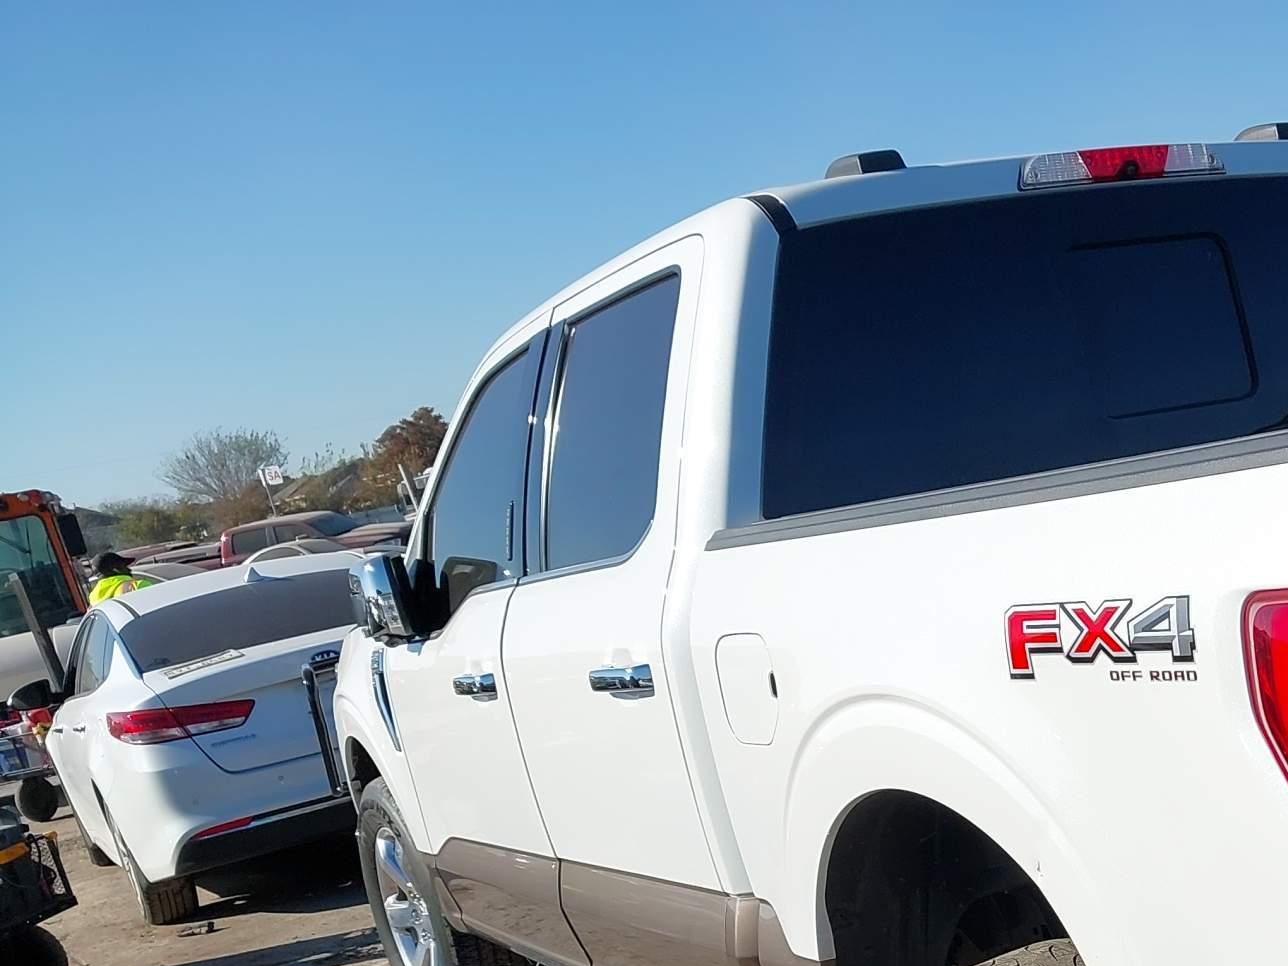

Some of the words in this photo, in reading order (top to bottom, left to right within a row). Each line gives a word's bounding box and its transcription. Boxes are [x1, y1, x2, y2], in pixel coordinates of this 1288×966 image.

[1003, 594, 1197, 680] FX4
[1110, 670, 1143, 682] OFF
[1150, 669, 1198, 682] ROAD
